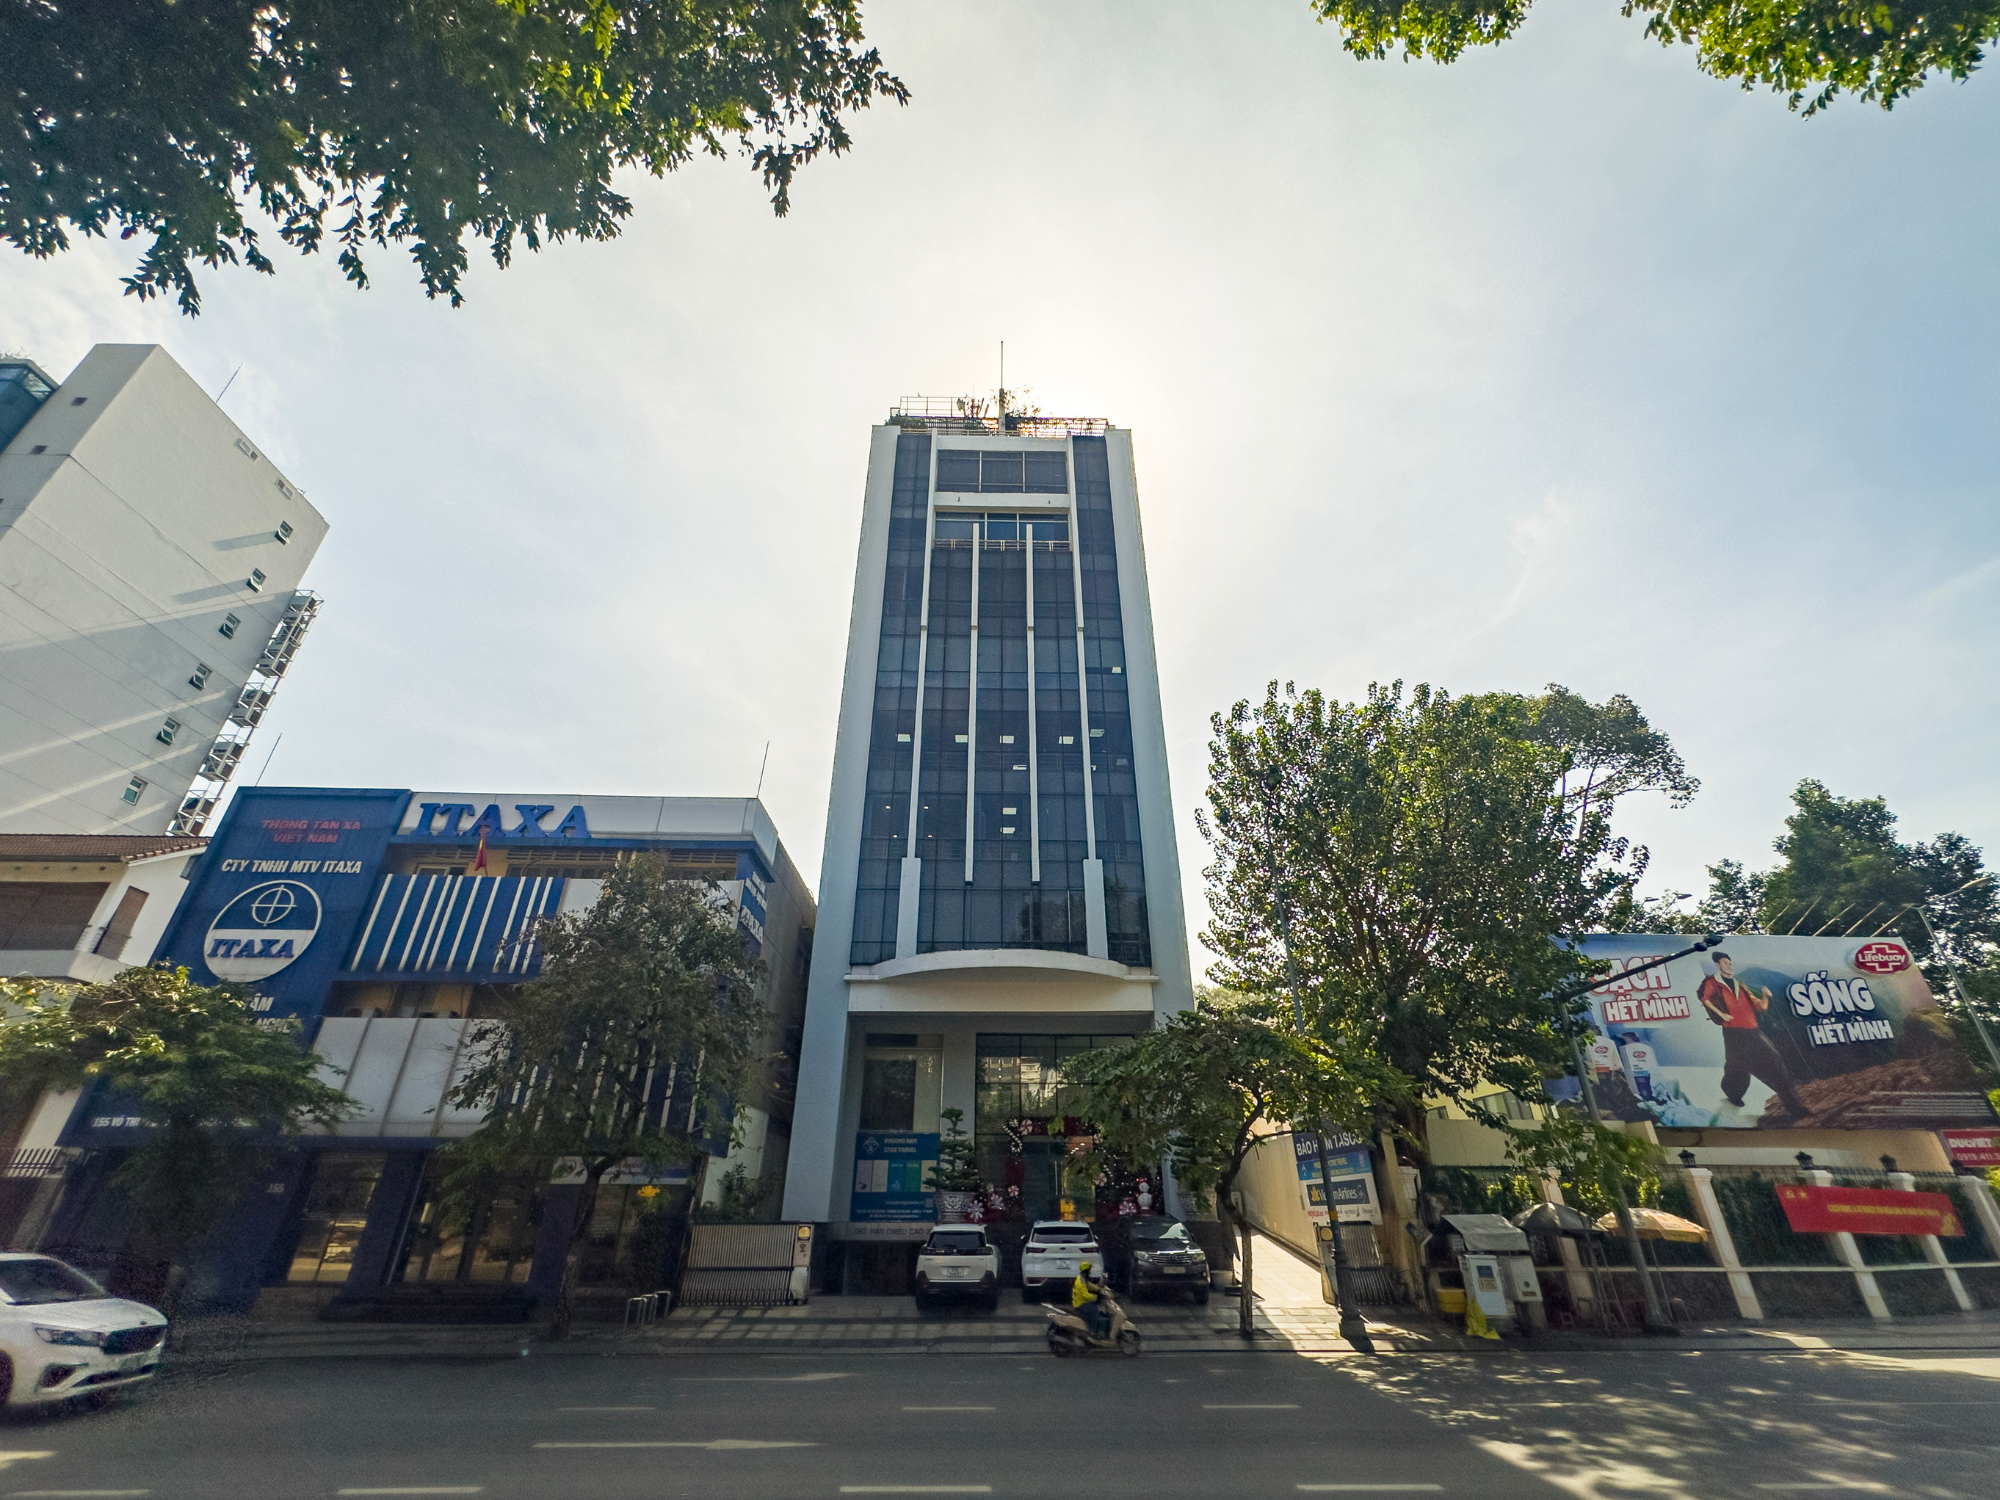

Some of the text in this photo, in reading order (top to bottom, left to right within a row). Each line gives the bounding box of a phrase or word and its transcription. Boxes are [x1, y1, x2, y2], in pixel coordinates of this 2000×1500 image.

[410, 802, 592, 838] ITAXA
[307, 833, 339, 843] NAM
[221, 859, 362, 874] CTY TNHH MTV ITAXA
[207, 938, 295, 959] ITAXA
[1858, 953, 1906, 963] Lifebuoy
[1789, 970, 1875, 1016] SỐNG
[1604, 993, 1690, 1021] HẾT MÌNH
[1810, 1016, 1894, 1045] HẾT MÌNH
[92, 1117, 112, 1128] 155
